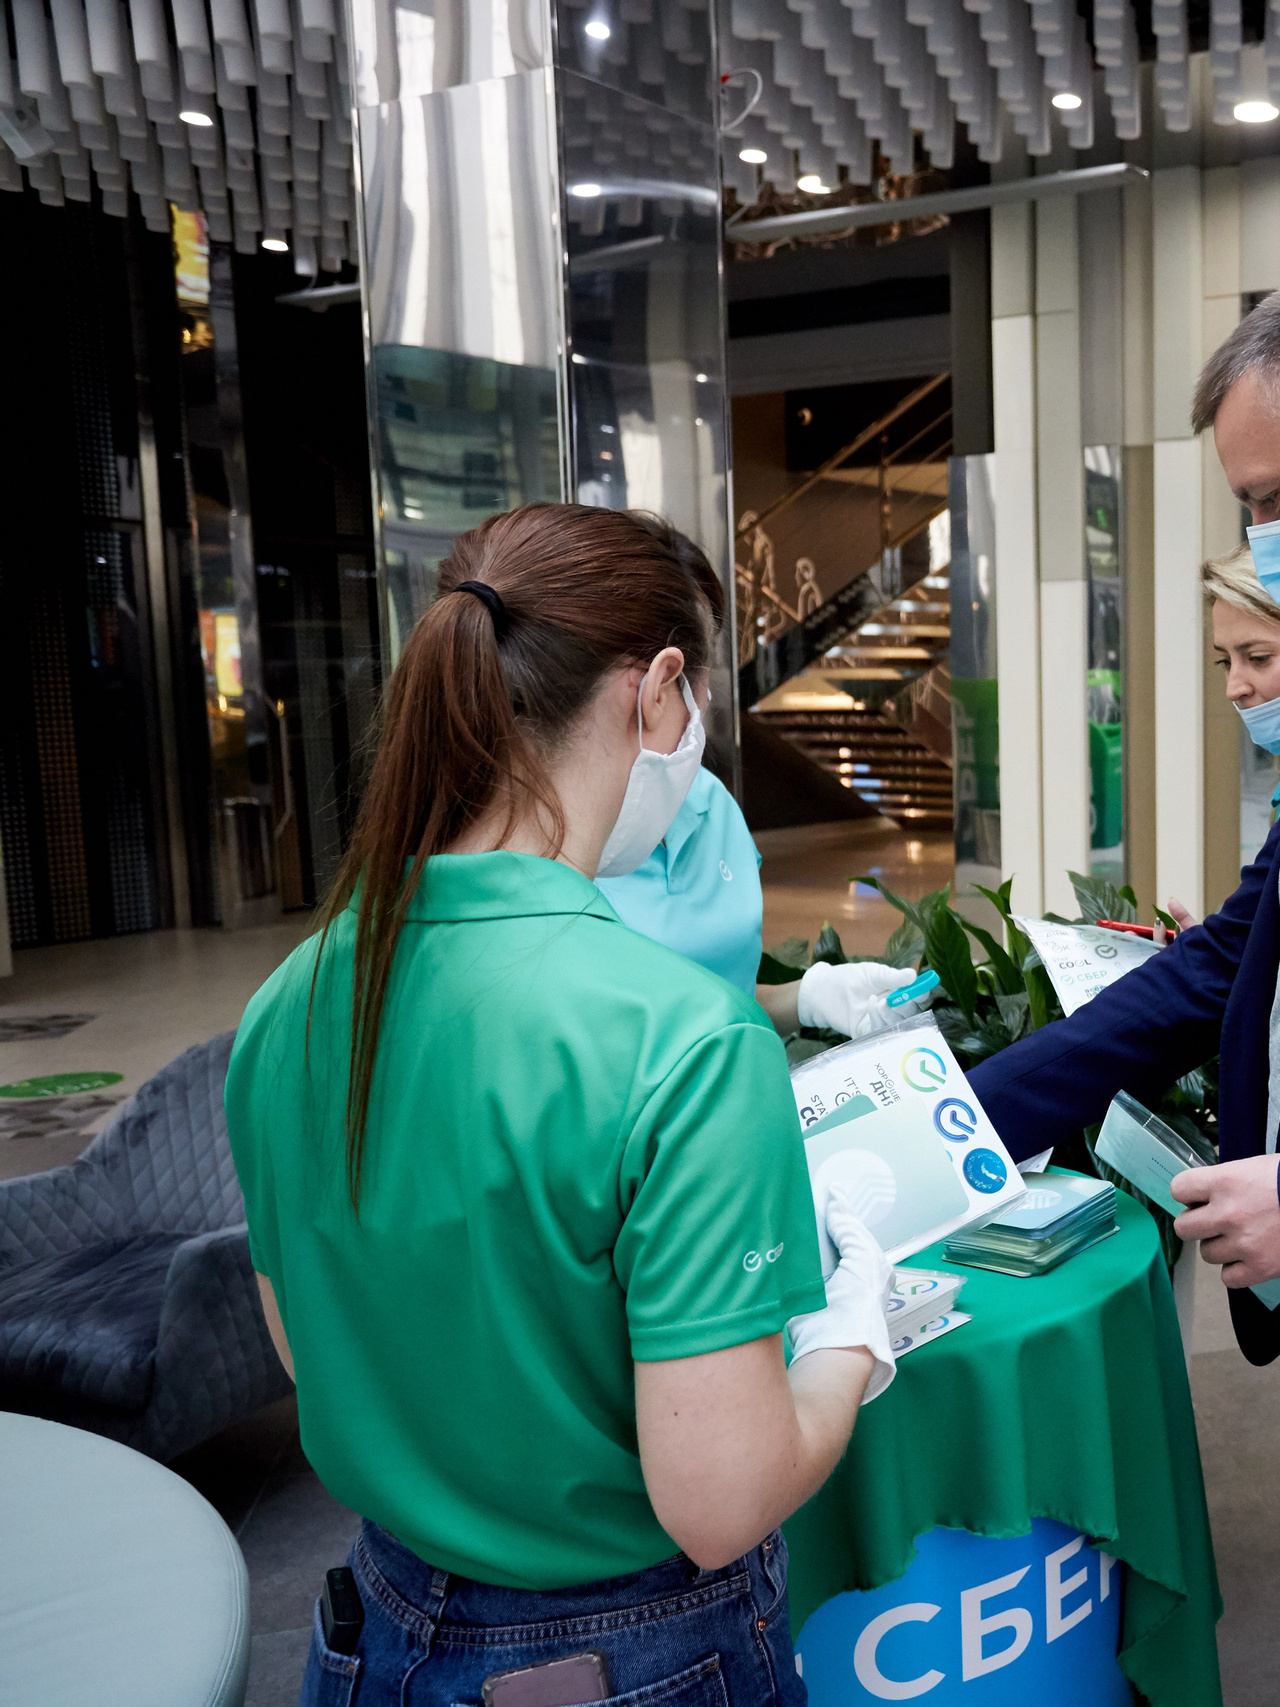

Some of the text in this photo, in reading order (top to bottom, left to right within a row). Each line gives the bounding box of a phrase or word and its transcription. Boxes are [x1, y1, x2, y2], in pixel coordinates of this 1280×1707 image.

[1059, 959, 1092, 970] COOL
[1077, 970, 1108, 982] СБЕР
[810, 1094, 829, 1116] STA
